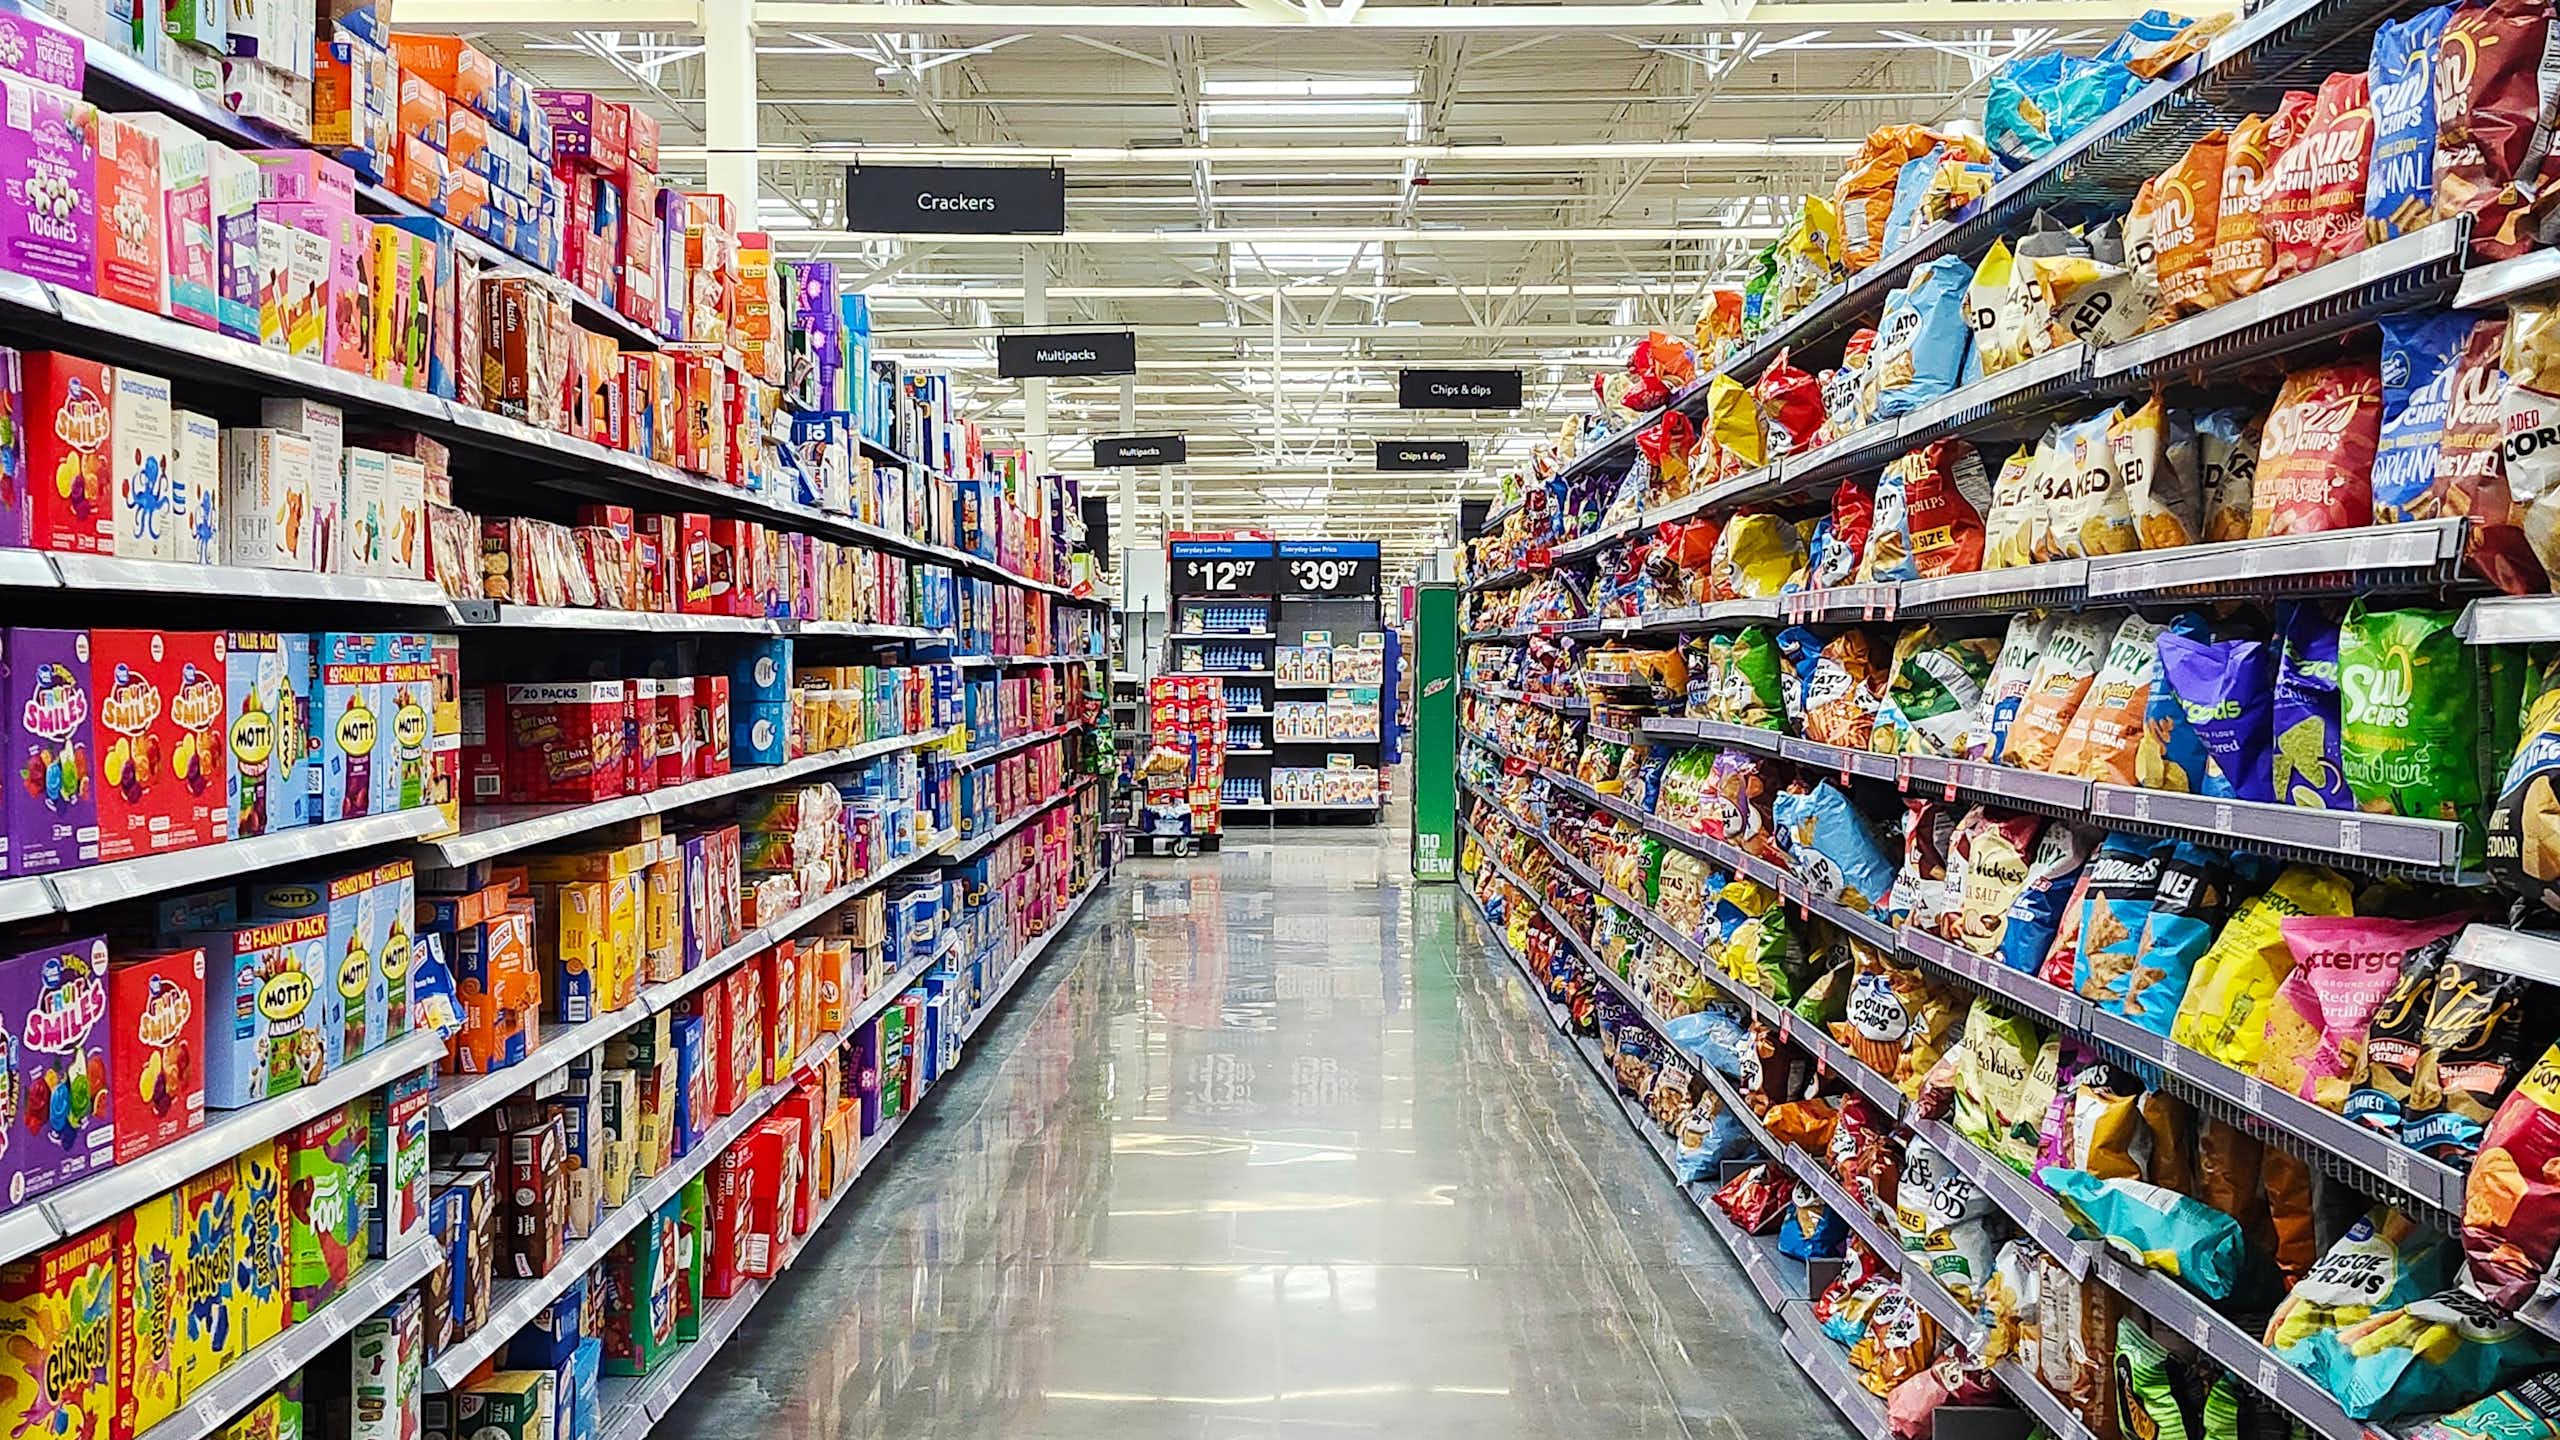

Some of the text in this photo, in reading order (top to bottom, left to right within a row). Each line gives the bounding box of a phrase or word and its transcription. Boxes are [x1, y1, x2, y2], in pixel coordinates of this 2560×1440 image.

[2380, 105, 2422, 137] CHIPS
[2316, 161, 2359, 187] CHIPS
[918, 193, 995, 211] Crackers
[2221, 195, 2263, 217] HIPS
[27, 211, 77, 243] YOGGIES
[2157, 226, 2195, 254] CHIPS
[115, 236, 149, 266] YOGGIES
[491, 284, 501, 350] Peanut Butter
[2070, 292, 2112, 341] KED
[1037, 349, 1096, 363] Multipacks
[121, 379, 168, 401] bettergoods
[1431, 384, 1491, 396] Chips & dips
[57, 411, 110, 446] SMILES
[2505, 410, 2540, 435] ADED
[1119, 447, 1160, 458] Multipacks
[2298, 433, 2341, 452] CHIPS
[2504, 424, 2560, 463] COR
[1400, 452, 1446, 461] Chips & dips
[260, 435, 270, 507] bettergoods
[2118, 459, 2144, 488] KED
[1176, 546, 1203, 555] Everyday
[1217, 546, 1232, 554] Price
[1281, 546, 1337, 555] Everyday Low Price
[1920, 531, 1945, 548] SIZE
[260, 632, 277, 650] PACK
[2046, 634, 2095, 668] MPLY
[2003, 645, 2040, 670] MPLY
[365, 665, 382, 682] PACK
[523, 688, 578, 699] 20 PACKS
[2342, 664, 2412, 725] Sun
[26, 692, 86, 732] SMILES
[104, 690, 160, 729] SMILES
[173, 688, 223, 727] SMILES
[569, 748, 590, 760] bits
[2371, 754, 2421, 784] Onion
[2489, 808, 2511, 831] HITE
[1419, 833, 1440, 848] DO
[1420, 849, 1437, 858] THE
[2486, 836, 2520, 858] EDDAR
[1419, 858, 1452, 872] DEW
[1975, 888, 2001, 902] SALT
[239, 917, 327, 948] 40 FAMILY PACK
[45, 978, 86, 1012] FRUIT
[2320, 991, 2386, 1006] Red Qui
[25, 986, 106, 1049] SMILES
[141, 992, 190, 1043] SMILES
[269, 1012, 305, 1037] ANIMALS
[2368, 1042, 2419, 1059] SHARING
[725, 1152, 736, 1168] 30
[1943, 1176, 1973, 1202] PE
[1934, 1190, 1966, 1220] OD
[59, 1243, 87, 1275] FAMILY
[87, 1232, 111, 1262] PACK
[254, 1198, 270, 1287] Gushers
[121, 1241, 134, 1300] PACK
[188, 1237, 232, 1309] ushers
[150, 1261, 168, 1362] Gushers
[121, 1305, 132, 1389] FAMILY
[47, 1319, 108, 1402] Gushers
